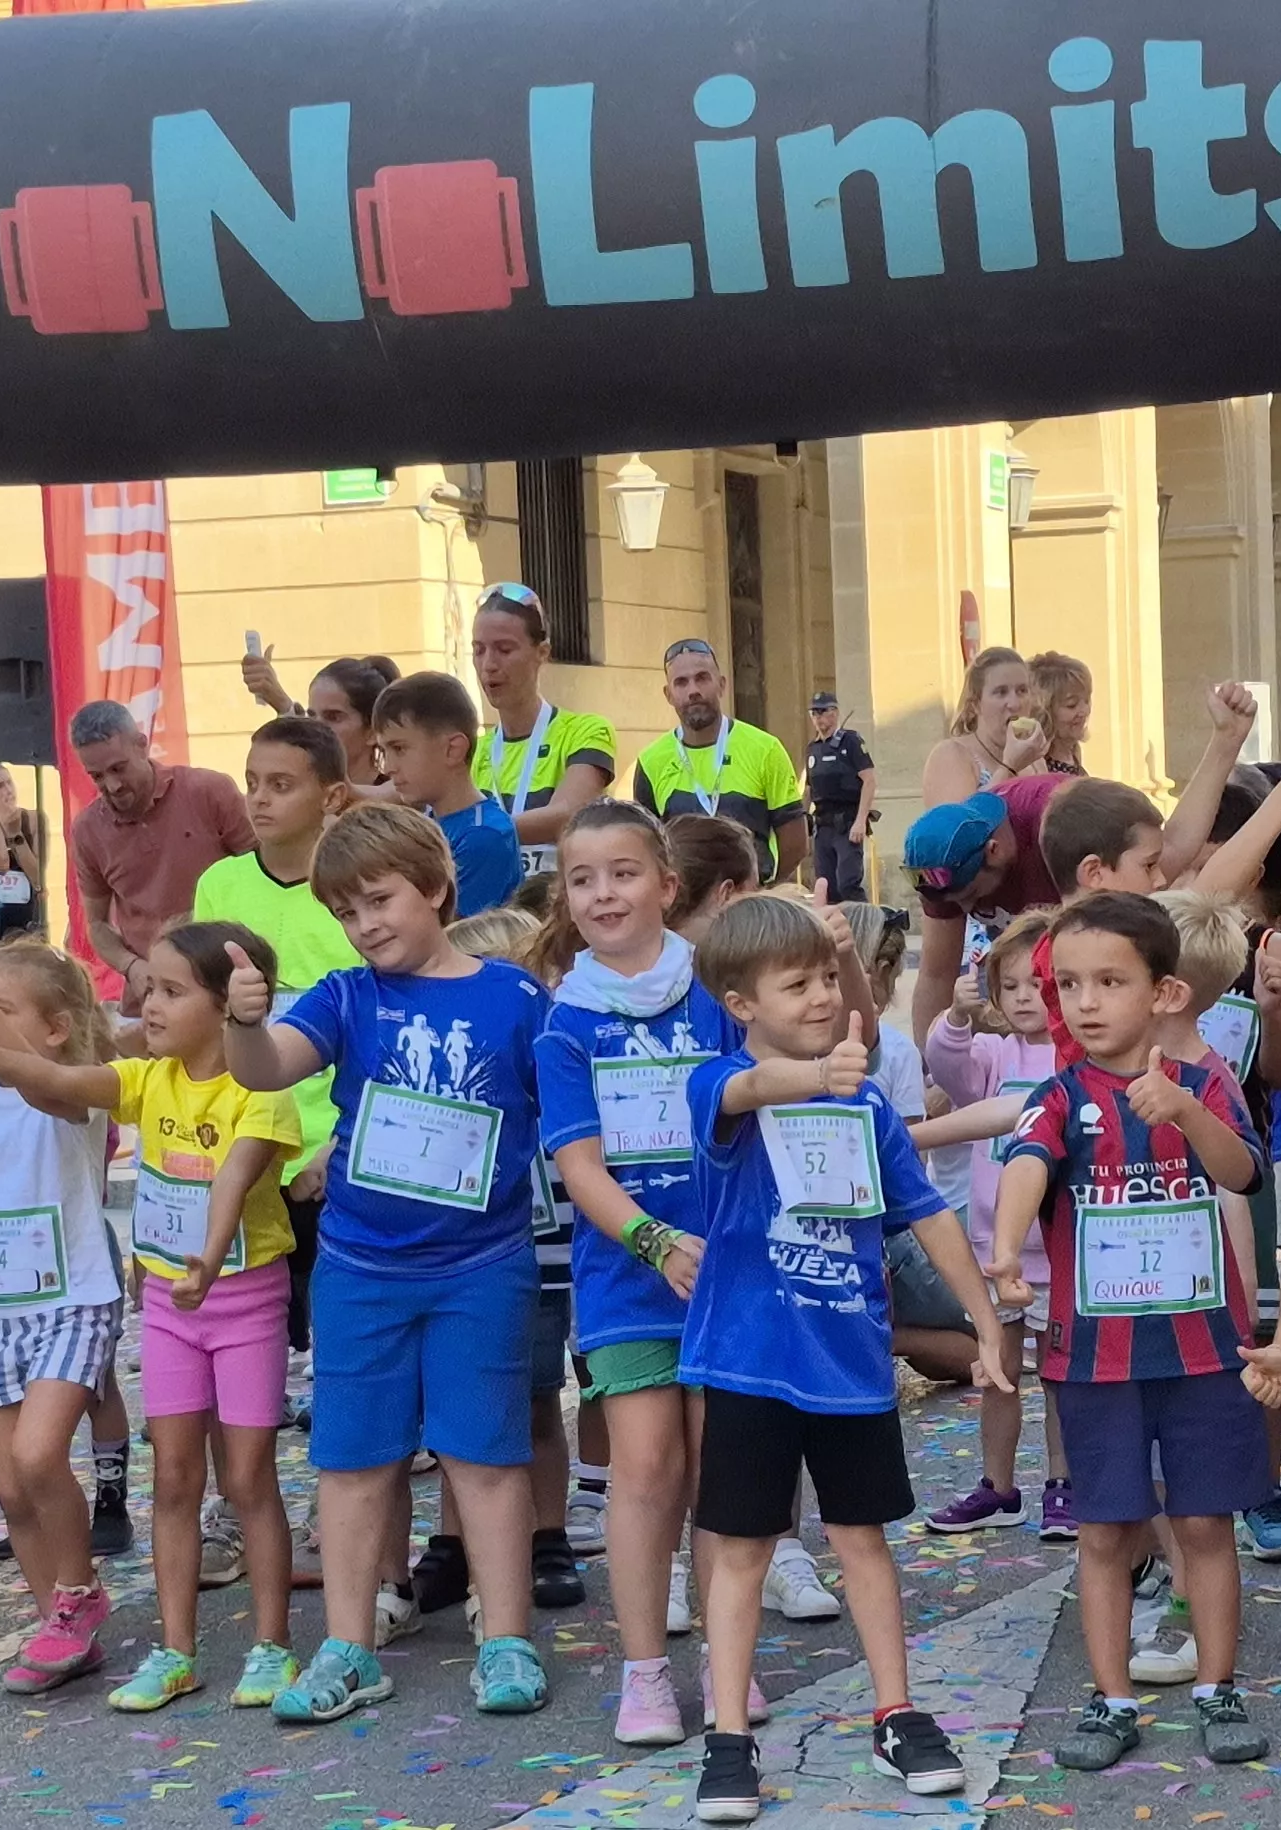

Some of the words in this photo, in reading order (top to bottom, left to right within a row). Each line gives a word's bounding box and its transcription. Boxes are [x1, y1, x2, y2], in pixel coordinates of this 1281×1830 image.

[657, 1100, 668, 1122] 2
[158, 1116, 176, 1136] 13
[419, 1136, 431, 1158] 1
[805, 1151, 827, 1174] 52
[1069, 1175, 1211, 1210] Huesca
[166, 1212, 184, 1234] 31
[1139, 1250, 1162, 1273] 12
[1094, 1279, 1165, 1299] QUIQUE
